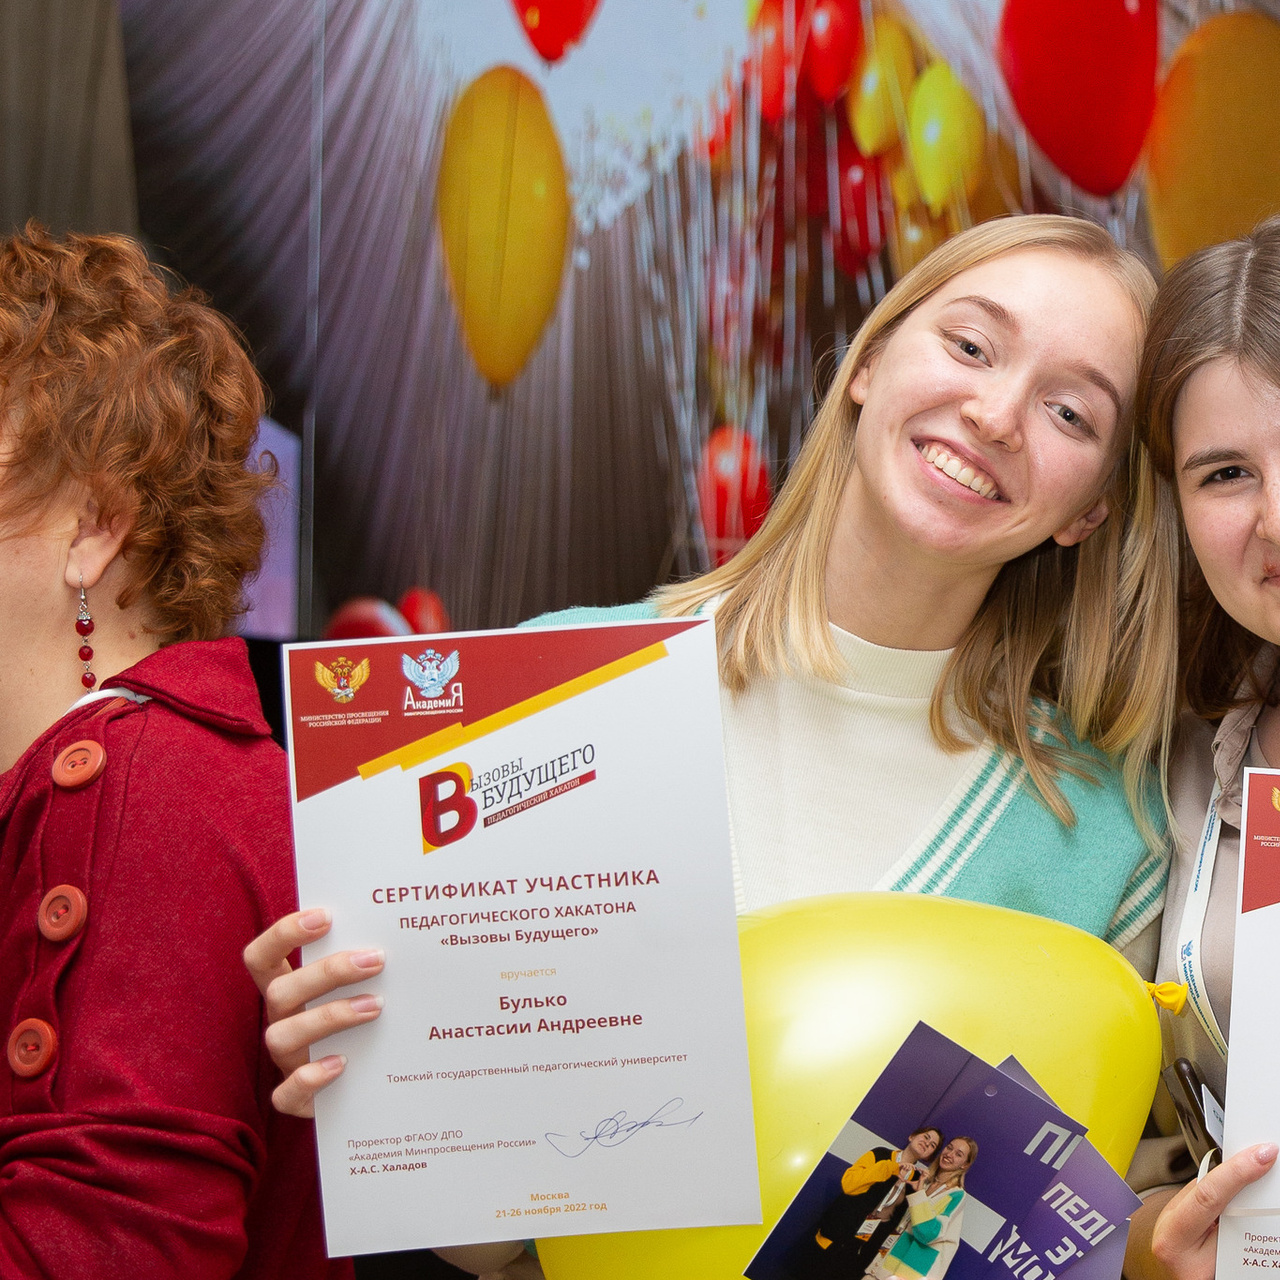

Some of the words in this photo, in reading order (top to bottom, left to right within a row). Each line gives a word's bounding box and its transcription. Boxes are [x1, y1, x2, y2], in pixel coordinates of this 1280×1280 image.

[300, 712, 346, 722] МИНИСТЕРСТВО
[482, 744, 595, 810] БУДУЩЕГО
[487, 793, 548, 826] ПЕДАГОГИЧЕСКИЙ
[548, 777, 580, 800] ХАКАТОН
[372, 879, 518, 904] СЕРТИФИКАТ
[525, 869, 660, 893] УЧАСТНИКА
[400, 907, 550, 930] ПЕДАГОГИЧЕСКОГО
[554, 901, 637, 918] ХАКАТОНА
[440, 931, 511, 946] «Вызовы
[515, 925, 599, 943] Будущего»
[500, 968, 557, 981] вручается
[499, 994, 568, 1014] Булько
[428, 1022, 532, 1041] Анастасии
[537, 1012, 643, 1035] Андреевне
[387, 1070, 434, 1084] Томский
[436, 1062, 530, 1081] государственный
[532, 1056, 618, 1074] педагогический
[621, 1053, 688, 1068] университет
[347, 1135, 402, 1150] Проректор
[404, 1131, 438, 1144] ФГАОУ
[441, 1130, 463, 1143] ДПО
[348, 1149, 403, 1163] «Академия
[405, 1141, 495, 1158] Минпросвещения
[497, 1138, 537, 1149] России»
[382, 1160, 428, 1173] Халадов
[530, 1191, 570, 1202] Москва
[495, 1208, 522, 1219] 21-26
[524, 1205, 562, 1217] ноября
[564, 1202, 587, 1213] 2022
[589, 1201, 608, 1212] год
